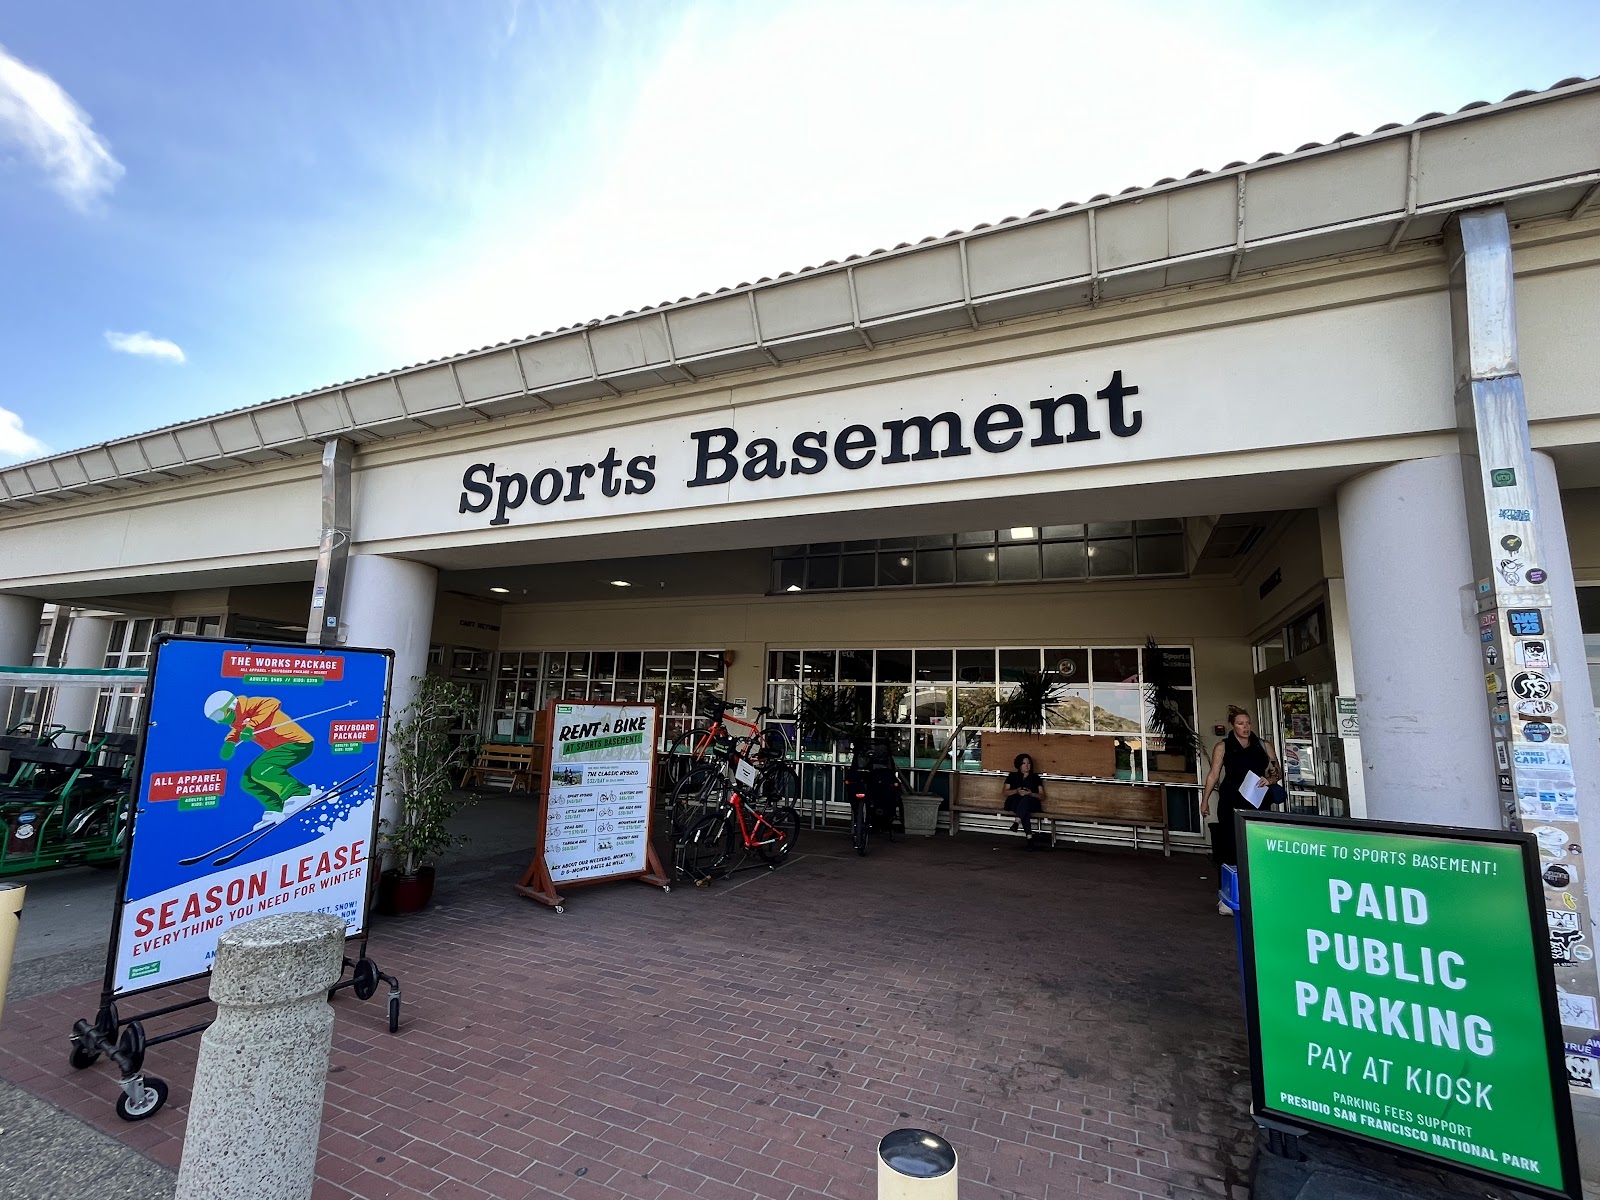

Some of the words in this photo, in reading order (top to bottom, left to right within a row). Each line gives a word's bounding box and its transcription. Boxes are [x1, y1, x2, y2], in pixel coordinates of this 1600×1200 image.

[459, 447, 656, 525] Sports
[686, 370, 1143, 488] Basement
[230, 656, 251, 666] THE
[255, 657, 291, 668] WORKS
[294, 659, 337, 670] PACKAGE
[333, 732, 367, 740] PACKAGE
[559, 722, 601, 741] RENT
[602, 723, 609, 733] A
[613, 716, 647, 734] BIKE
[566, 745, 574, 753] AT
[576, 740, 602, 750] SPORTS
[604, 735, 641, 747] BASEMENT!
[1514, 756, 1547, 764] CAMP
[154, 777, 174, 787] ALL
[177, 774, 222, 785] APPAREL
[176, 783, 221, 794] PACKAGE
[1266, 838, 1327, 857] WELCOME
[1332, 845, 1348, 859] TO
[1353, 847, 1407, 866] SPORTS
[1412, 853, 1497, 876] BASEMENT!
[134, 870, 267, 938] SEASON
[280, 840, 365, 889] LEASE
[1328, 878, 1429, 926] PAID
[133, 913, 224, 957] EVERYTHING
[229, 904, 253, 921] YOU
[258, 895, 289, 912] NEED
[294, 883, 316, 900] FOR
[320, 868, 362, 890] WINTER
[334, 900, 358, 911] SNOW!
[341, 909, 357, 918] NOW
[1306, 928, 1467, 991] PUBLIC
[1295, 980, 1494, 1057] PARKING
[1564, 1042, 1592, 1055] TRUE
[1308, 1042, 1352, 1075] PAY
[1363, 1056, 1393, 1085] AT
[1406, 1065, 1493, 1111] KIOSK
[1333, 1091, 1380, 1114] PARKING
[1384, 1104, 1413, 1122] FEES
[1417, 1112, 1472, 1138] SUPPORT
[1280, 1091, 1330, 1116] PRESIDIO
[1333, 1107, 1356, 1123] SAN
[1360, 1115, 1428, 1143] FRANCISCO
[1432, 1133, 1499, 1162] NATIONAL
[1502, 1152, 1540, 1174] PARK
